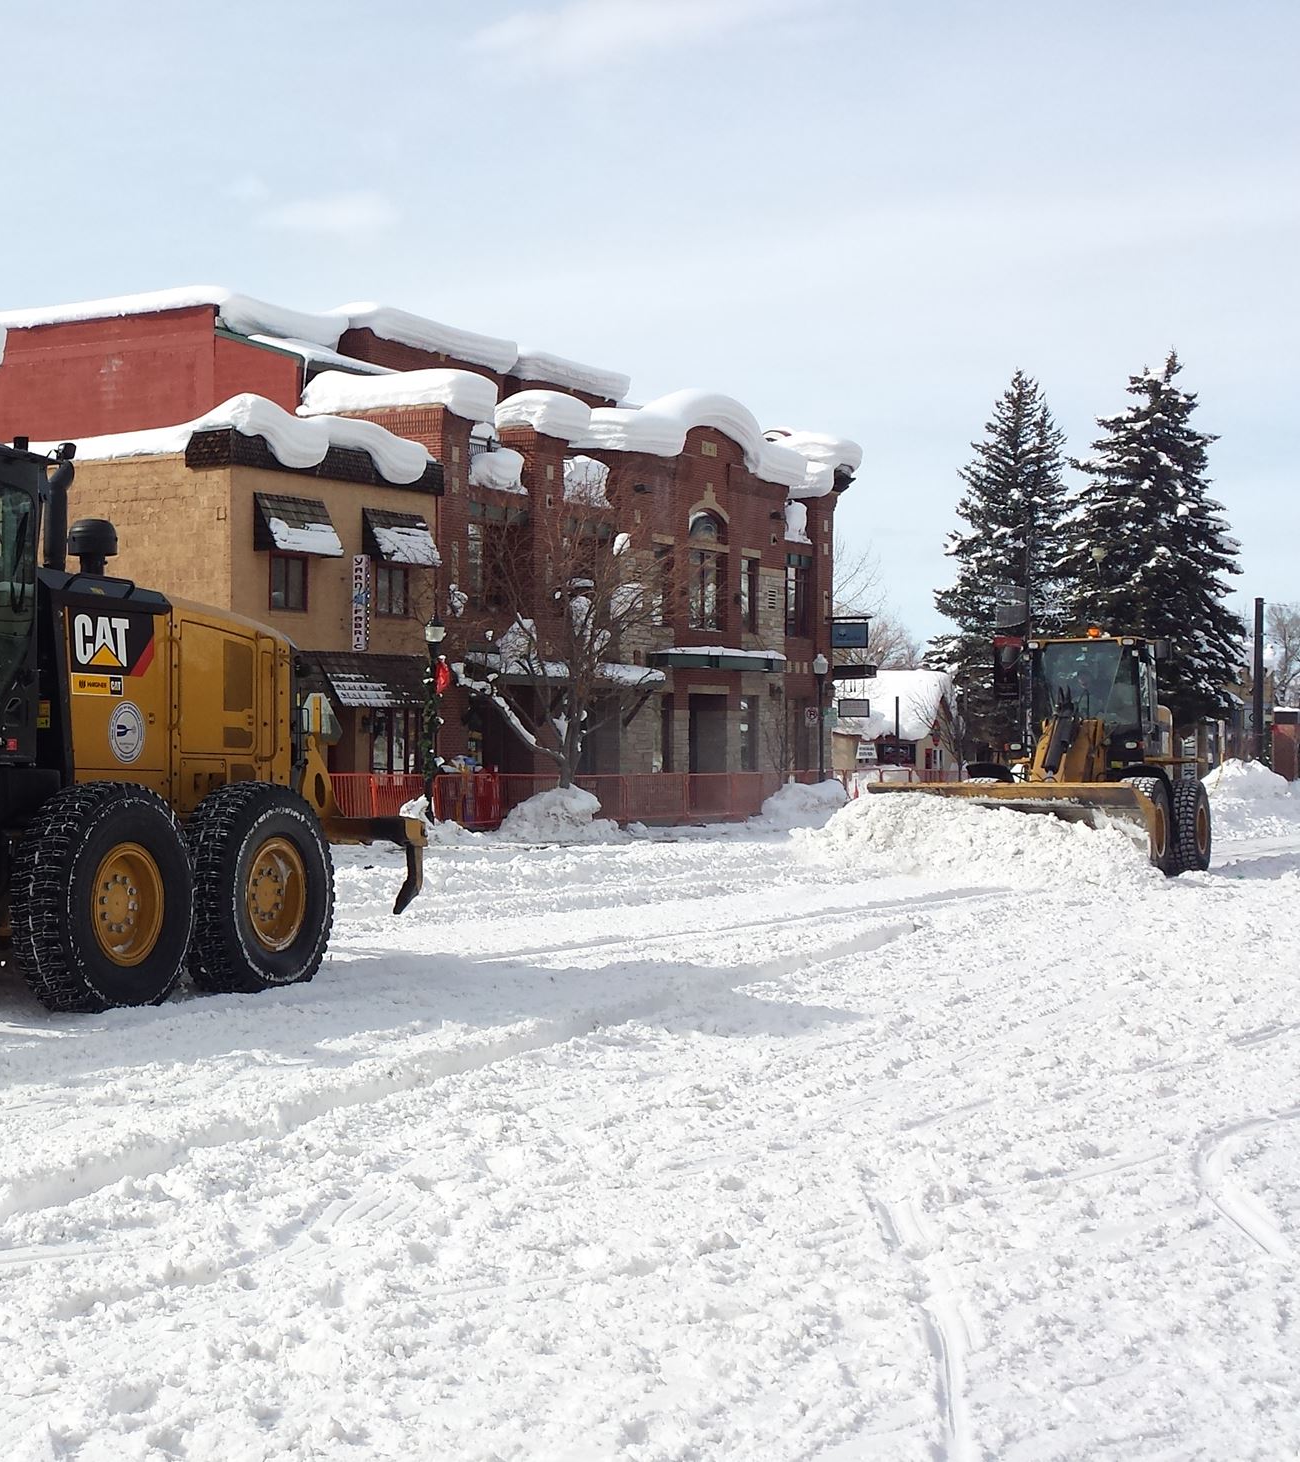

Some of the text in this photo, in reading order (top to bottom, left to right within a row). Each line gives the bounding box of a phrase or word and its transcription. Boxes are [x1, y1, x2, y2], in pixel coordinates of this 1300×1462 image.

[74, 613, 130, 668] CAT
[353, 608, 363, 650] FABRIC
[110, 680, 121, 691] CAT
